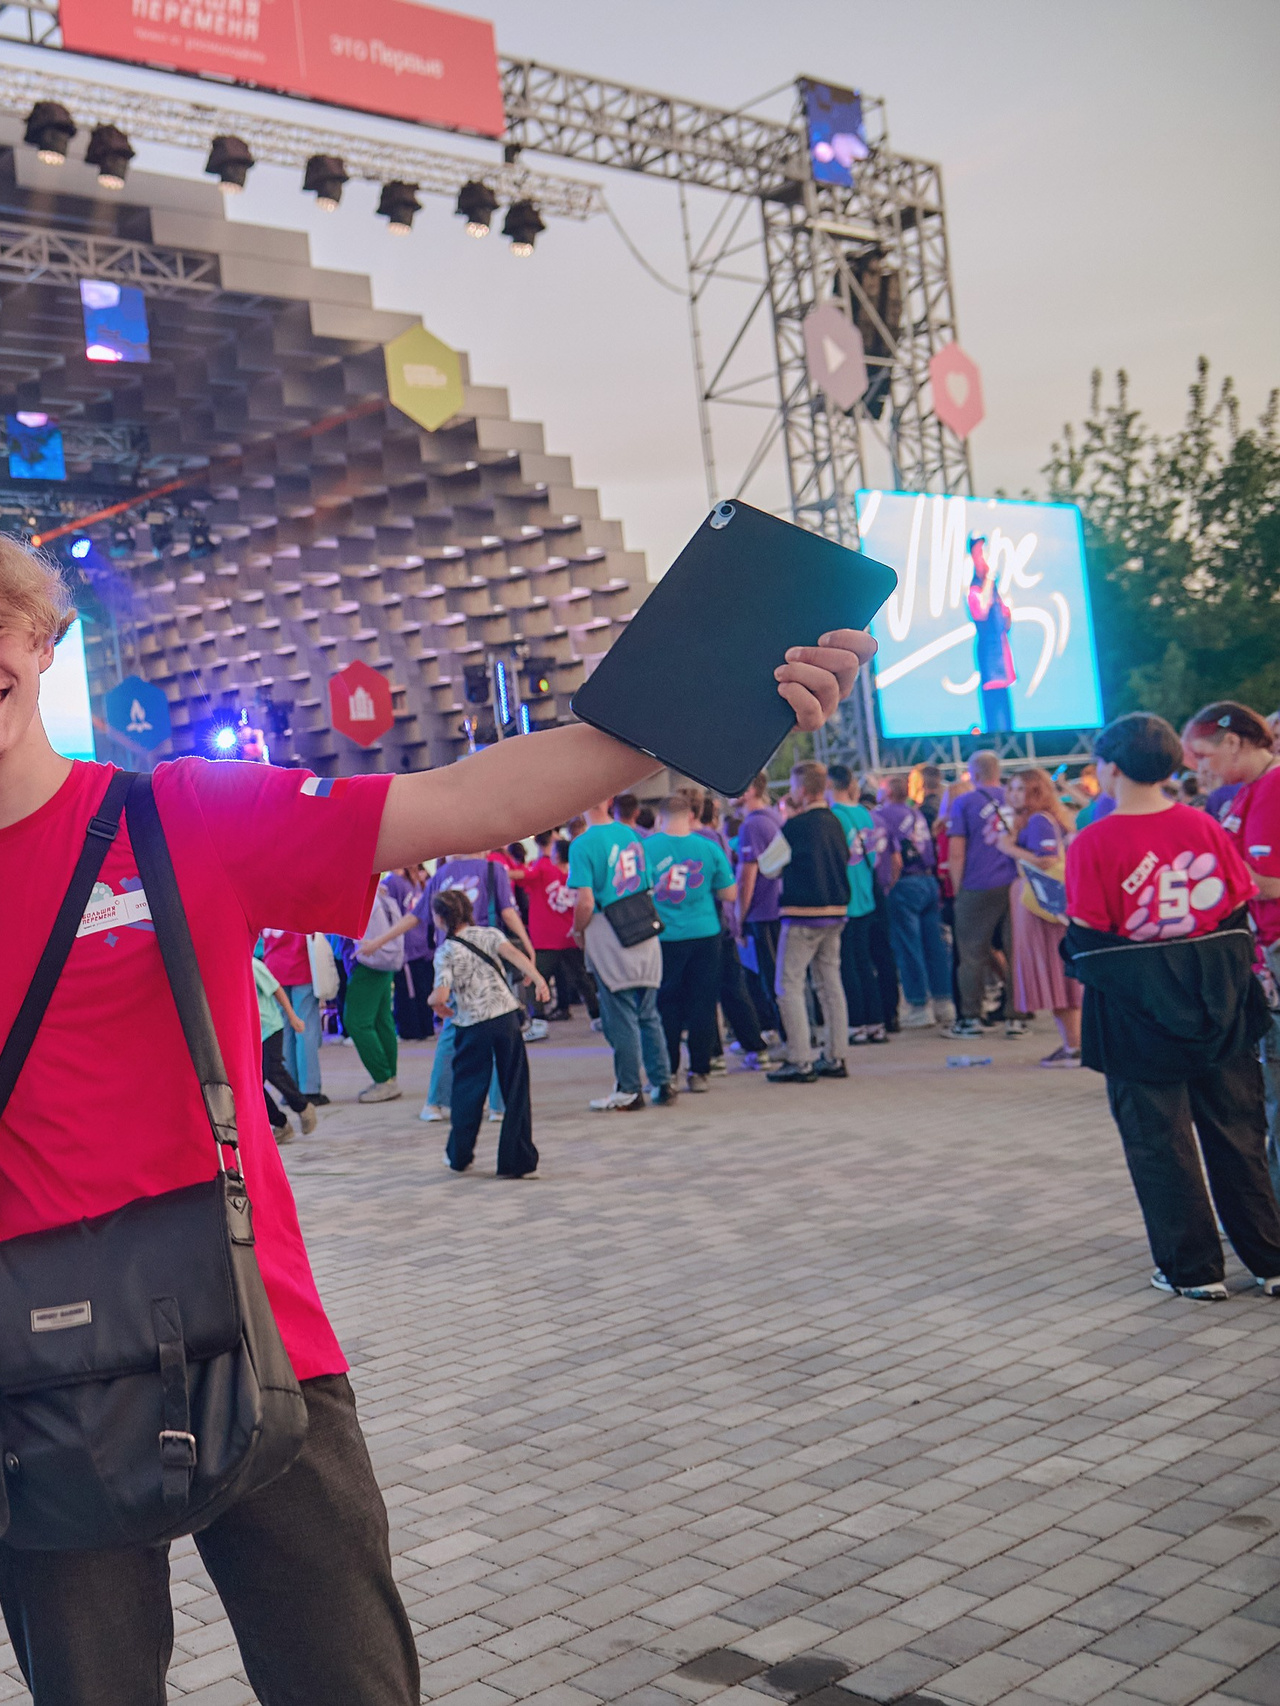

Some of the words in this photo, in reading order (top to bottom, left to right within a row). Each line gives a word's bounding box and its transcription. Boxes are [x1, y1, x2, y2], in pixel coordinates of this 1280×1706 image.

[621, 849, 636, 879] 5
[669, 865, 688, 891] 5
[1158, 870, 1189, 920] 5
